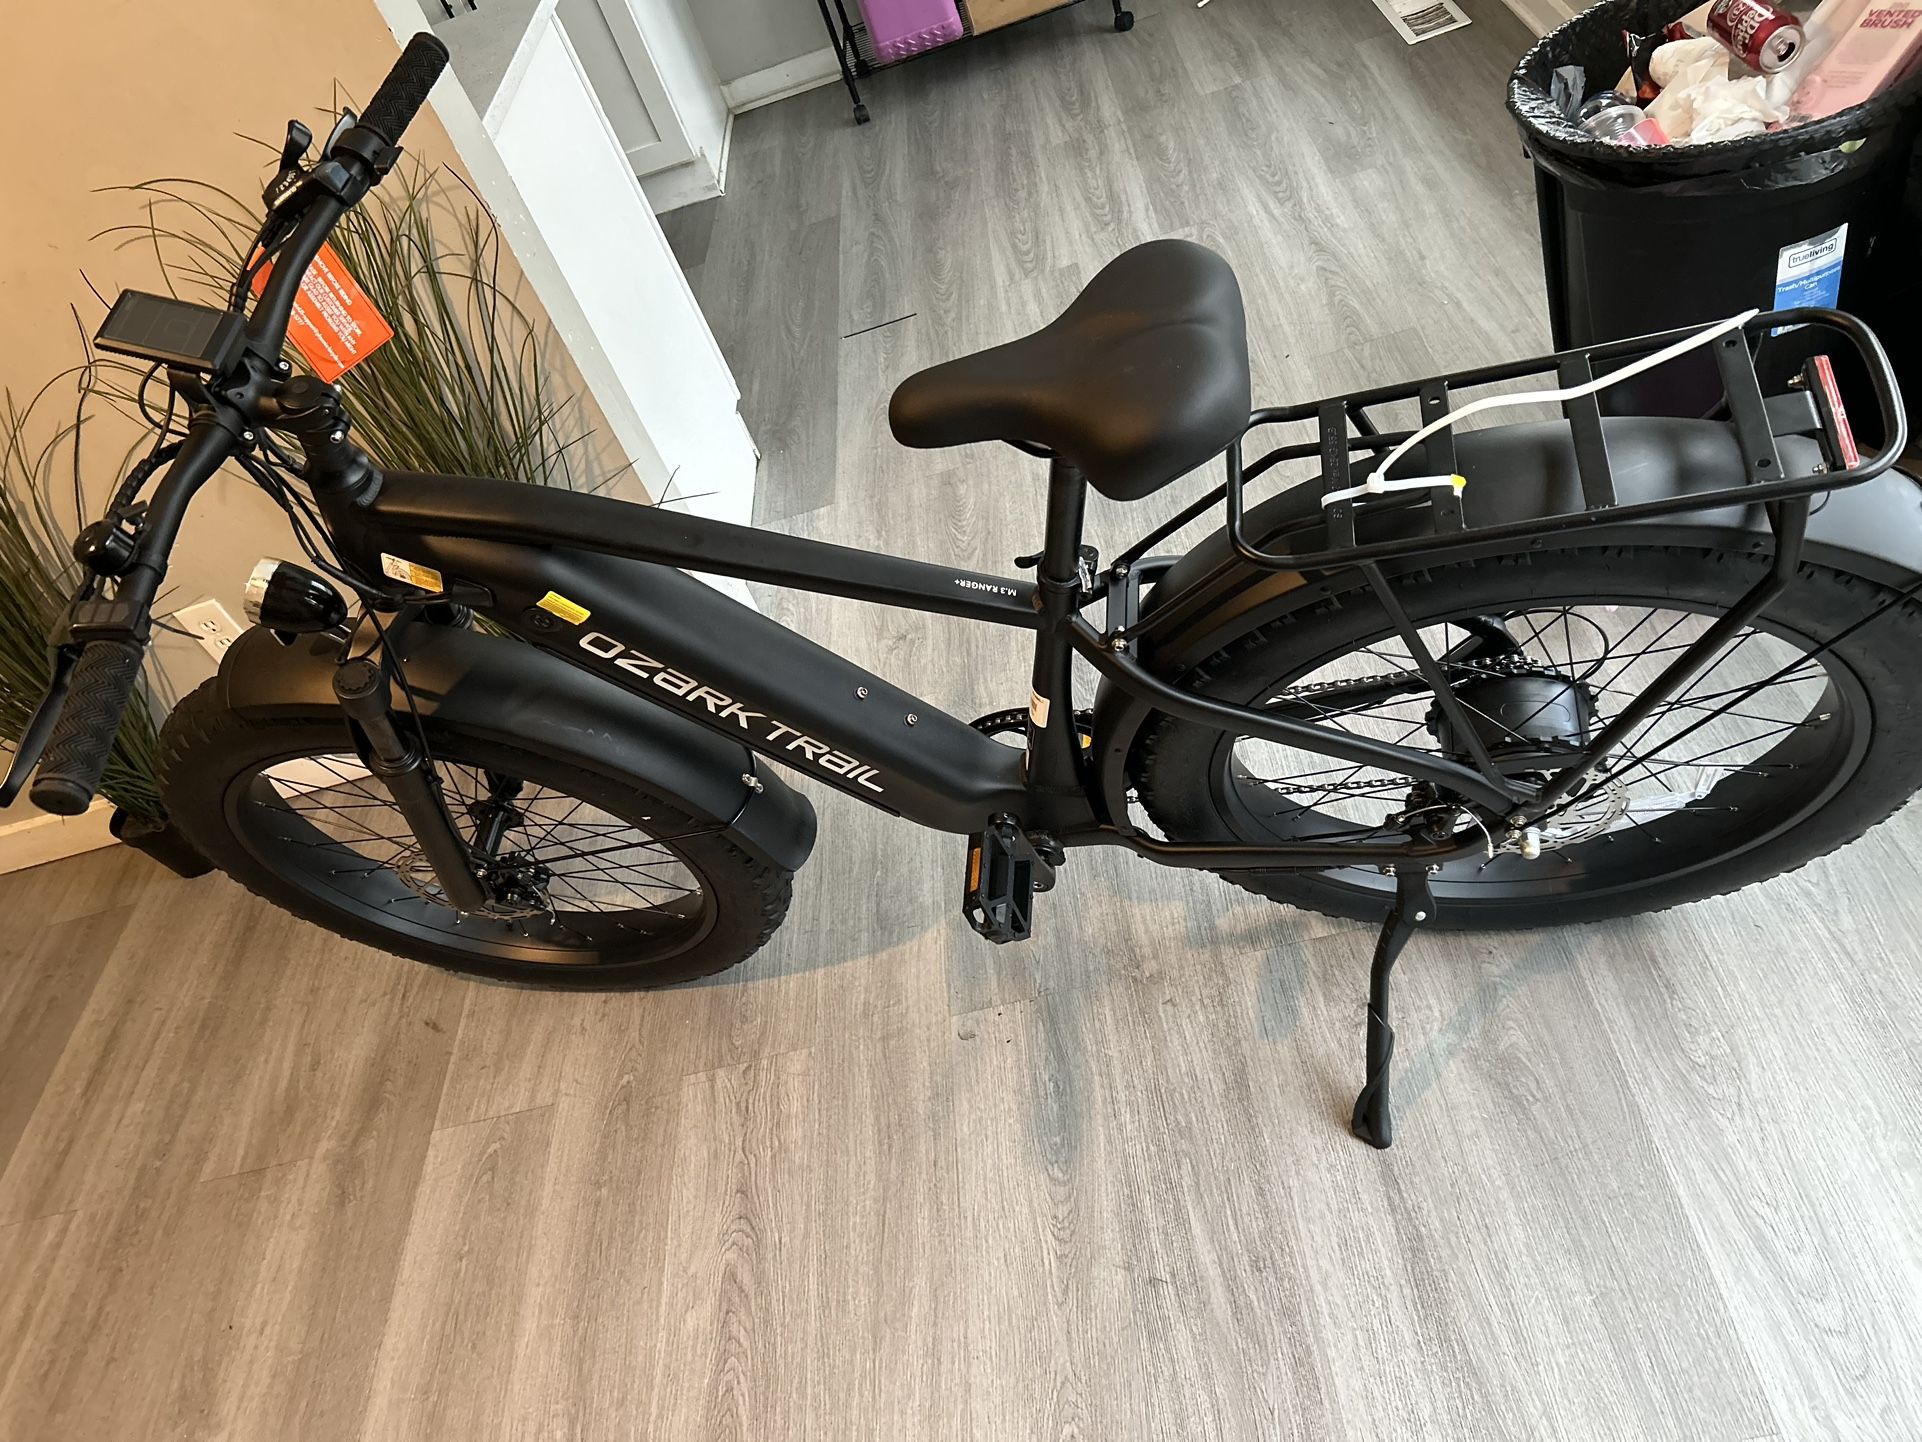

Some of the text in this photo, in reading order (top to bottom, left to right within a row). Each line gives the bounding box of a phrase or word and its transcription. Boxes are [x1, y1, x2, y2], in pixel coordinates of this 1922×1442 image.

[1868, 9, 1922, 18] VENTED
[1859, 19, 1915, 28] BRUSH
[1792, 243, 1834, 264] trueliving
[954, 578, 1017, 597] M.3 RANGER+
[579, 632, 884, 793] OZARK TRAIL
